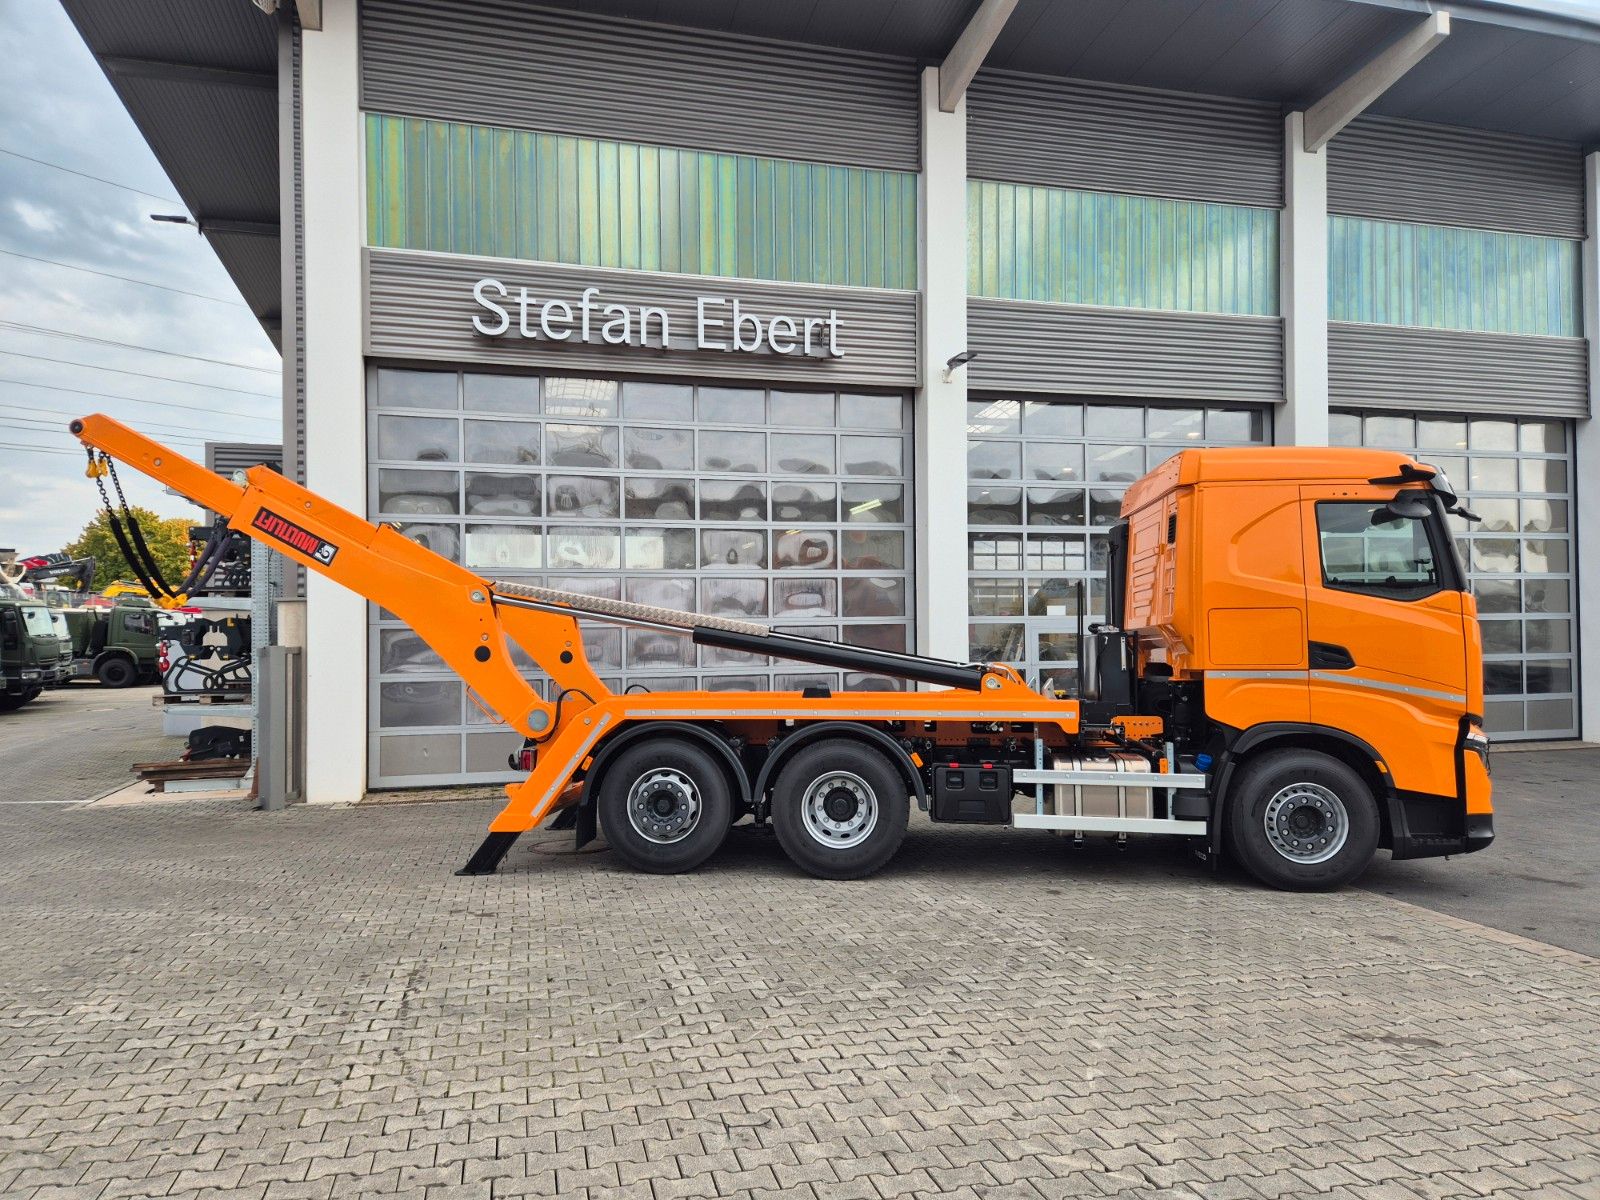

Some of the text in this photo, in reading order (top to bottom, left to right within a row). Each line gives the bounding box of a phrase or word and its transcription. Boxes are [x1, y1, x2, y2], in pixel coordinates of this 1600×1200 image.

[472, 278, 845, 357] Stefan Ebert
[254, 511, 319, 554] MULTILIFT
